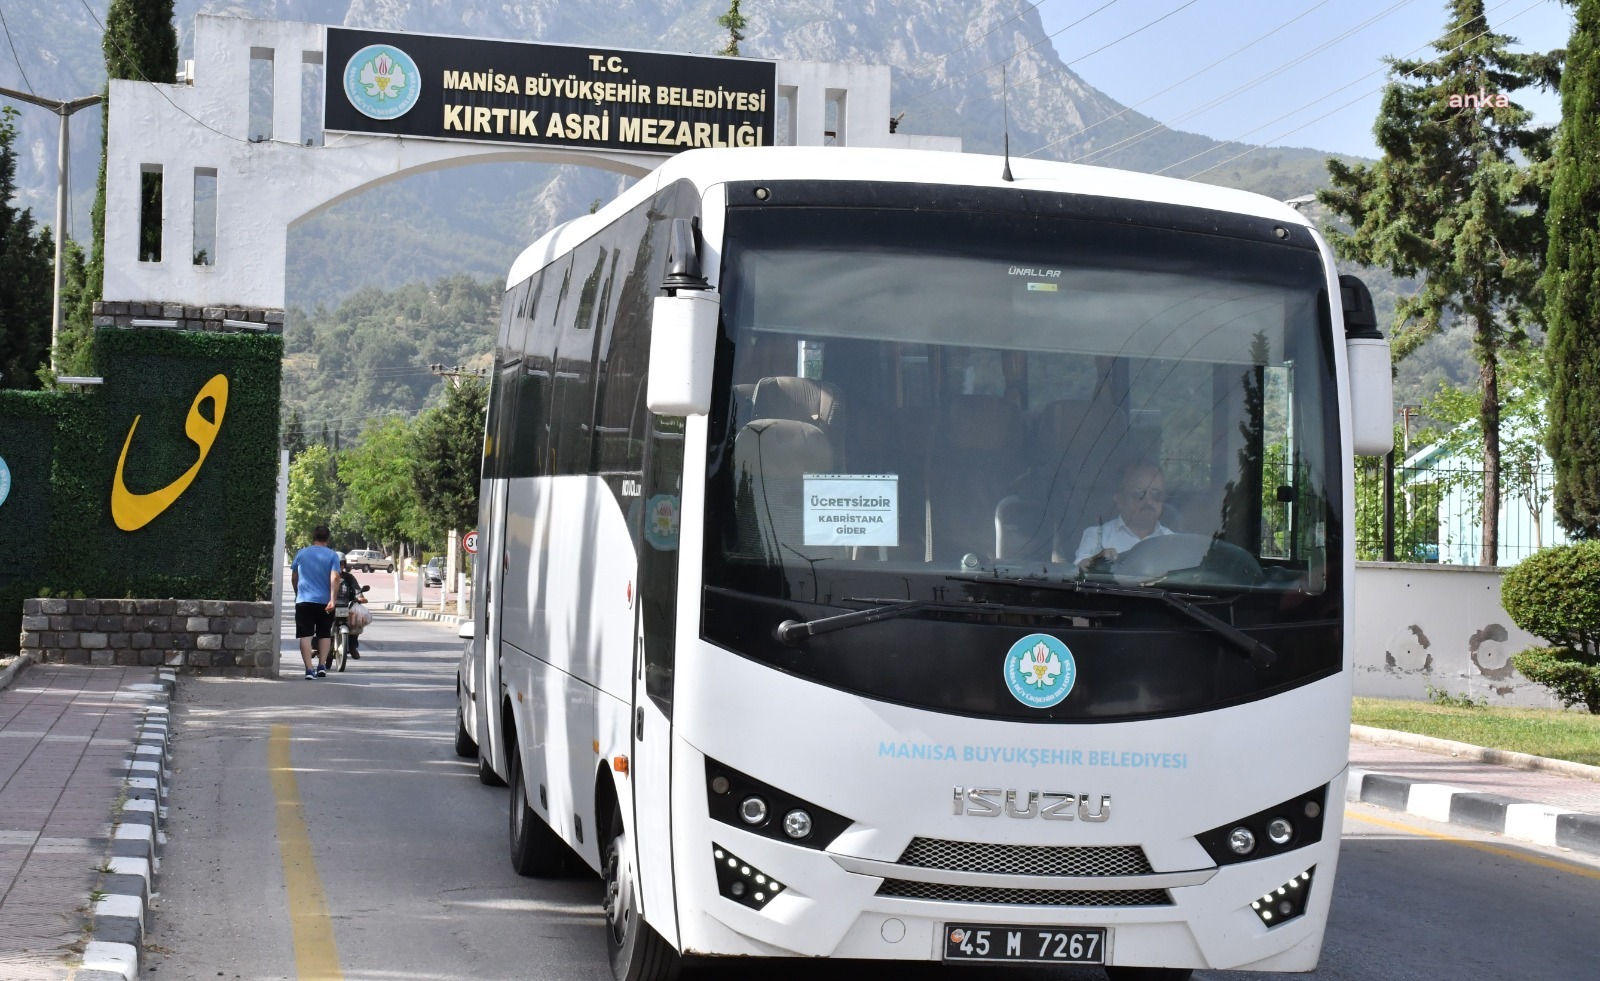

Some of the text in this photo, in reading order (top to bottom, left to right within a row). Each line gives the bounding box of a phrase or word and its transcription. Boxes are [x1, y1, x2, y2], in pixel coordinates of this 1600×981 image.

[588, 55, 629, 73] T.C.
[443, 68, 766, 112] MANİSA BÜYÜKŞEHİR BELEDİYESİ
[443, 104, 763, 148] KIRTIK ASRİ MEZARLIĞI
[1008, 265, 1062, 278] ÜNALLAR
[810, 495, 891, 507] ÜCRETSİZDİR
[818, 513, 884, 523] KABRİSTANA
[836, 525, 866, 535] GİDER
[467, 537, 477, 548] 3
[878, 741, 958, 761] MANİSA
[1088, 750, 1188, 769] BELEDİYESİ
[953, 785, 1111, 823] ISUZU
[959, 930, 1100, 959] 45 M 7267
